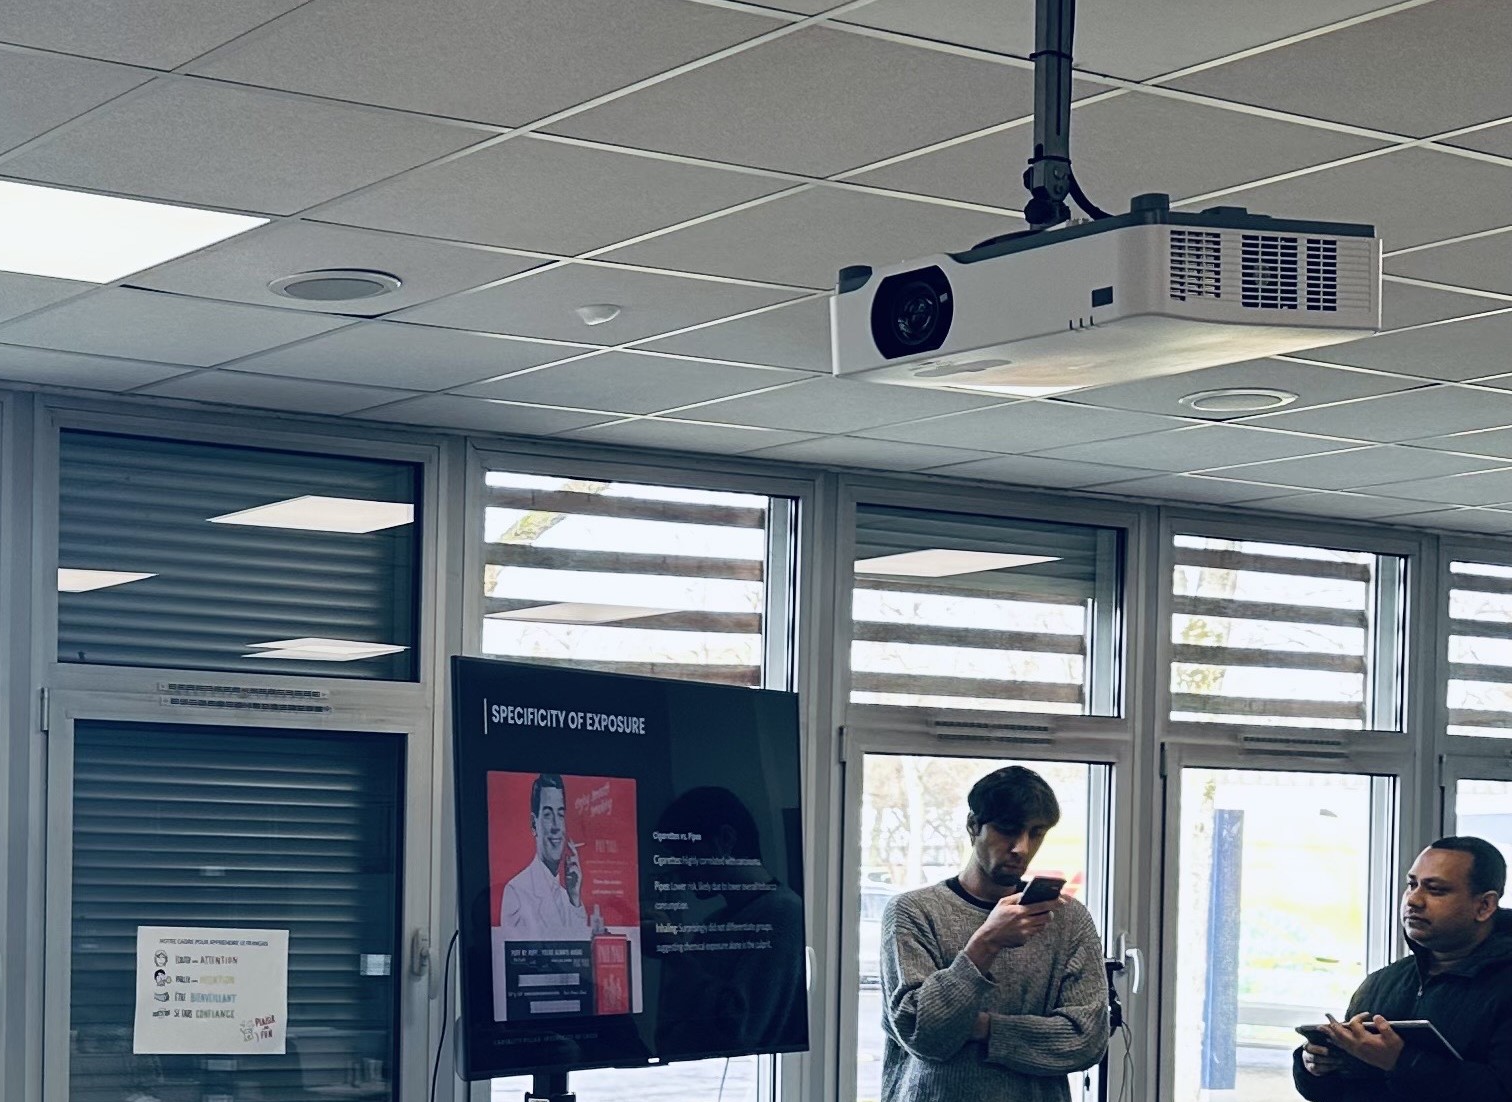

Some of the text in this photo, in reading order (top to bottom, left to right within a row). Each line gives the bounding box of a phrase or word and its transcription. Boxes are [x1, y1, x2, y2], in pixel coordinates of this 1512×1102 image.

[492, 705, 645, 734] SPECIFICITY OF EXPOSURE
